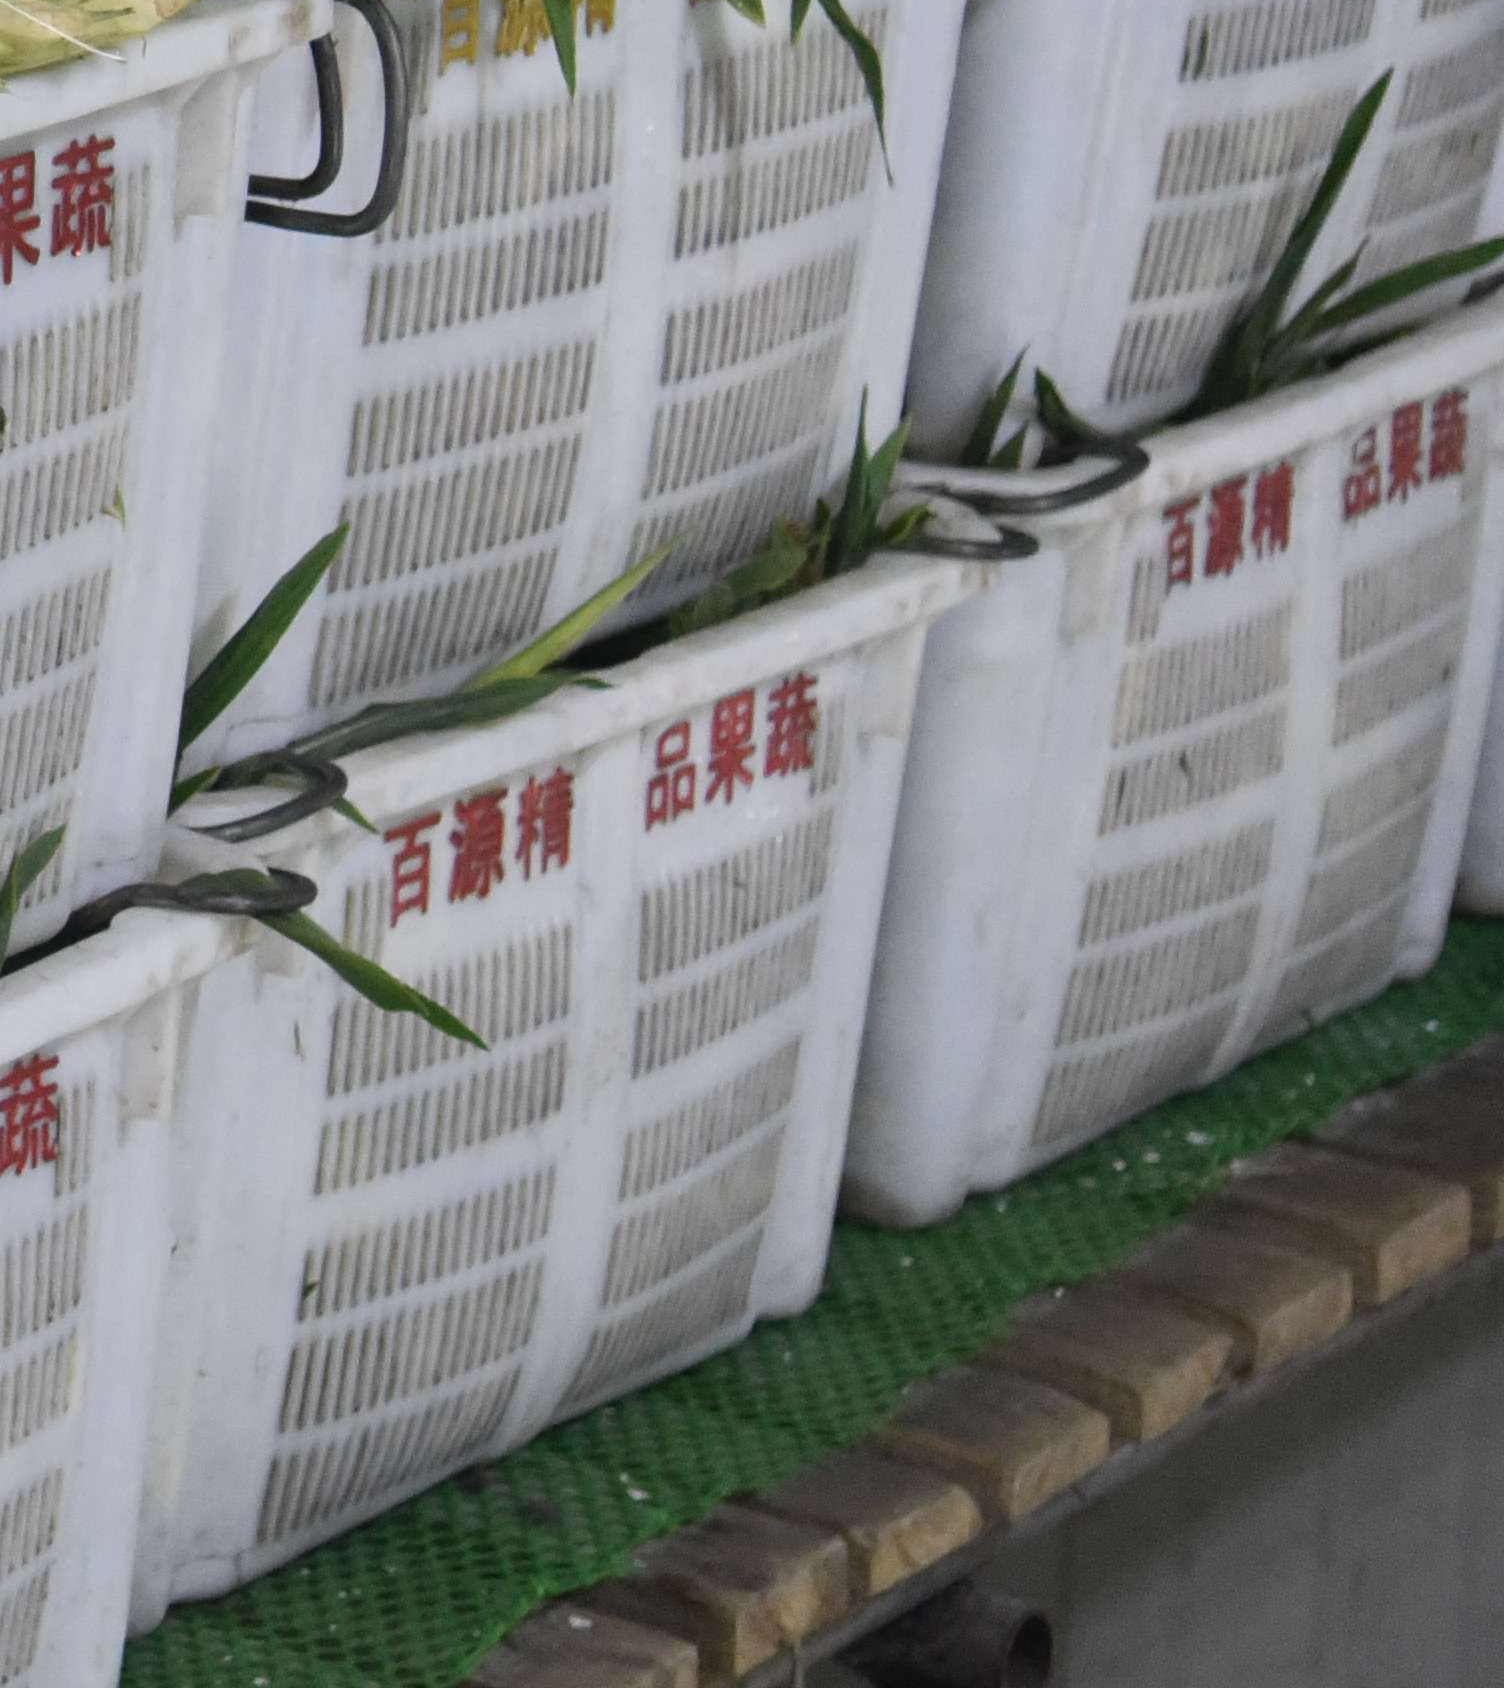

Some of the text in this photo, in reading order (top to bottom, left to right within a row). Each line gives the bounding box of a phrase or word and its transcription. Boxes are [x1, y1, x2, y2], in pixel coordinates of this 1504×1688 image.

[384, 671, 818, 929] 百源精 品果蔬
